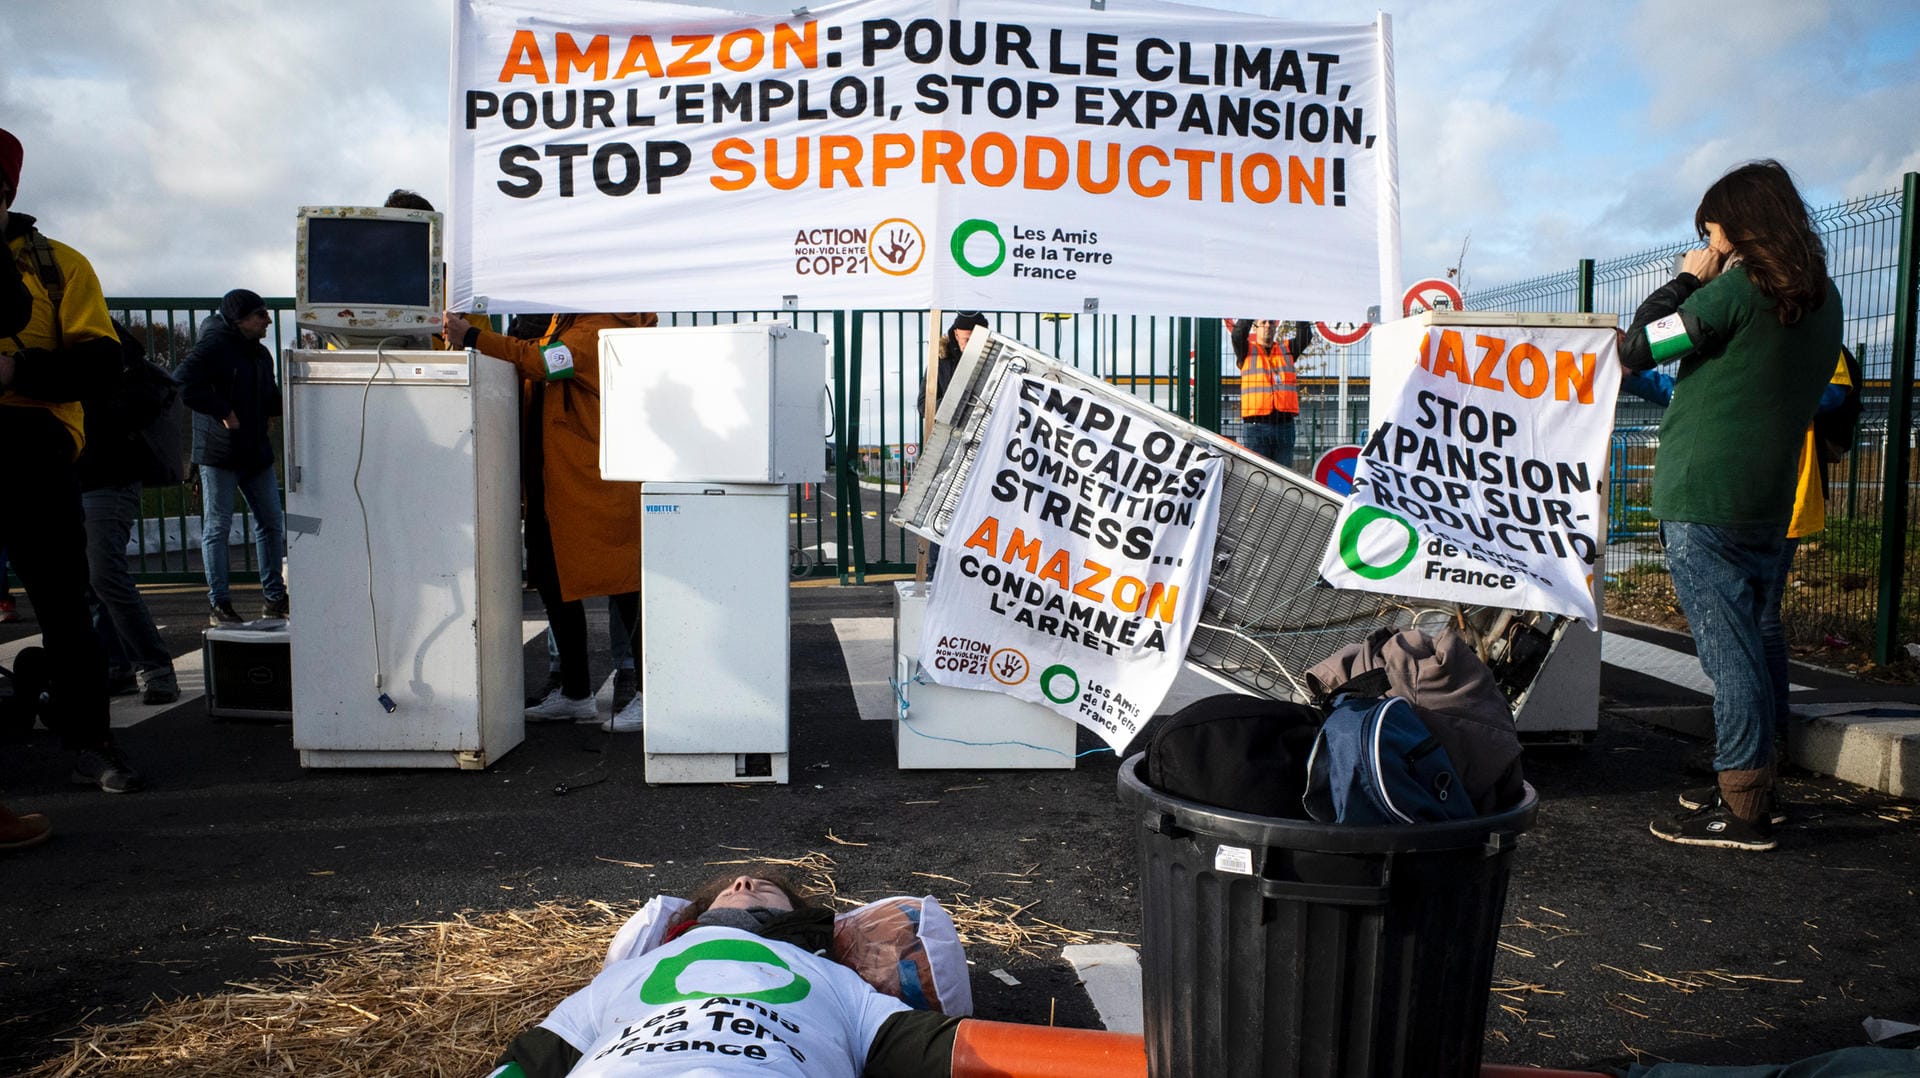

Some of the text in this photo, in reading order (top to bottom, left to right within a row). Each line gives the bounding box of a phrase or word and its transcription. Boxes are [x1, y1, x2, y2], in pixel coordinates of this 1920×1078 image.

[498, 18, 1352, 102] AMAZON: POUR LE CLIMAT,
[465, 73, 1376, 150] POUR L'EMPLOI, STOP EXPANSION,
[497, 129, 1347, 207] STOP SURPRODUCTION!
[794, 228, 867, 246] ACTION
[795, 246, 867, 256] NON-VIOLENTE
[1013, 225, 1098, 245] Les Amis
[1013, 245, 1113, 265] de la Terre
[795, 255, 869, 276] COP21
[1013, 263, 1077, 280] France
[1416, 390, 1517, 448] STOP
[1006, 438, 1196, 530] COMPÉTITION,
[1365, 459, 1590, 529] STOP SUR-
[991, 468, 1184, 568] STRESS...
[1427, 538, 1459, 558] de
[964, 515, 1180, 624] AMAZON
[1424, 561, 1517, 590] France
[959, 555, 1166, 652] CONDAMNÉ À
[937, 635, 992, 655] ACTION
[990, 592, 1121, 657] L'ARRÊT
[935, 656, 987, 675] COP21
[1079, 702, 1118, 735] France
[1082, 692, 1137, 735] de la Terre
[1087, 679, 1141, 718] Les Amis
[619, 996, 801, 1040] Les Amis
[653, 1020, 689, 1037] la
[705, 1011, 807, 1063] Terre
[621, 1039, 768, 1061] France
